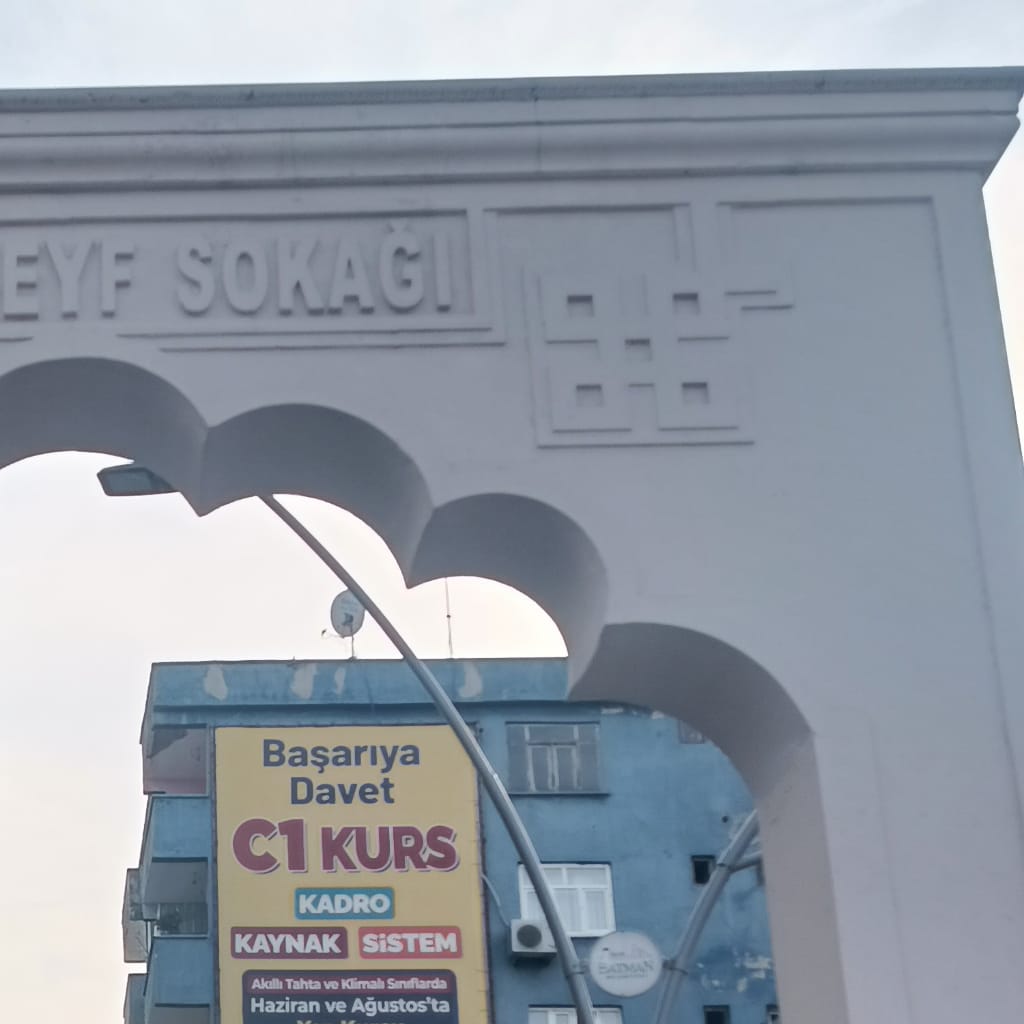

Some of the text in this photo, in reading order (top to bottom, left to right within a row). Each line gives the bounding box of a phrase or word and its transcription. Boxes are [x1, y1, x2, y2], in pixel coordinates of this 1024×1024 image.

[177, 222, 452, 317] SOKAĞI
[262, 738, 420, 774] Başarıya
[290, 776, 395, 805] Davet
[232, 817, 459, 873] C1 KURS
[298, 893, 391, 914] KADRO
[234, 933, 341, 954] KAYNAK
[285, 978, 321, 990] Tahta
[323, 980, 339, 990] ve
[250, 996, 450, 1017] Haziran ve Ağustos'ta
